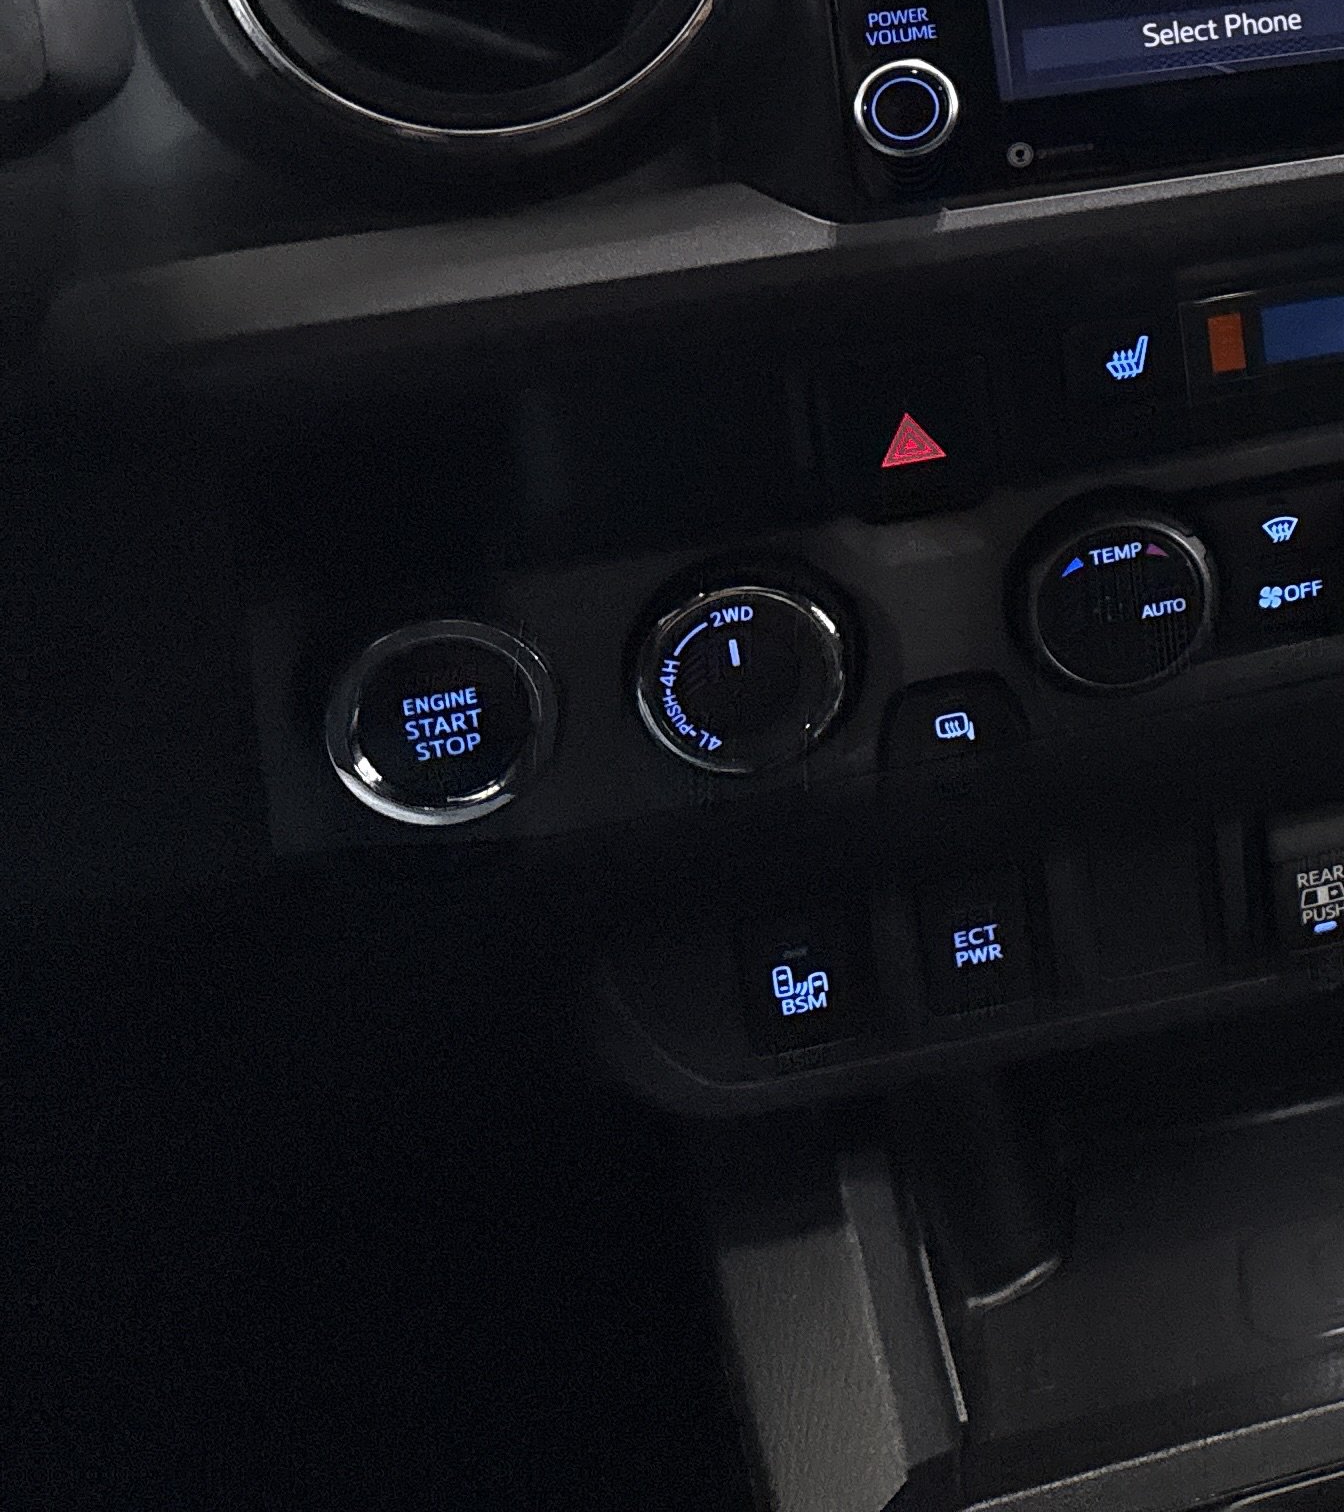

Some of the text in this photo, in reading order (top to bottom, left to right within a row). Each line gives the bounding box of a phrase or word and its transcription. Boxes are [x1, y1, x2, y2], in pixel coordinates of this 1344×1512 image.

[868, 8, 928, 27] POWER
[866, 25, 937, 46] VOLUME
[1143, 13, 1301, 47] Select Phone
[1089, 542, 1141, 565] TEMP
[1284, 580, 1323, 602] OFF
[710, 606, 753, 627] 2WD
[1142, 598, 1186, 618] AUTO
[403, 688, 478, 717] ENGINE
[405, 709, 482, 740] START
[415, 733, 481, 761] STOP
[1297, 865, 1344, 887] REAR
[953, 924, 998, 949] ECT
[955, 943, 1003, 968] PWR
[782, 992, 827, 1016] BSM
